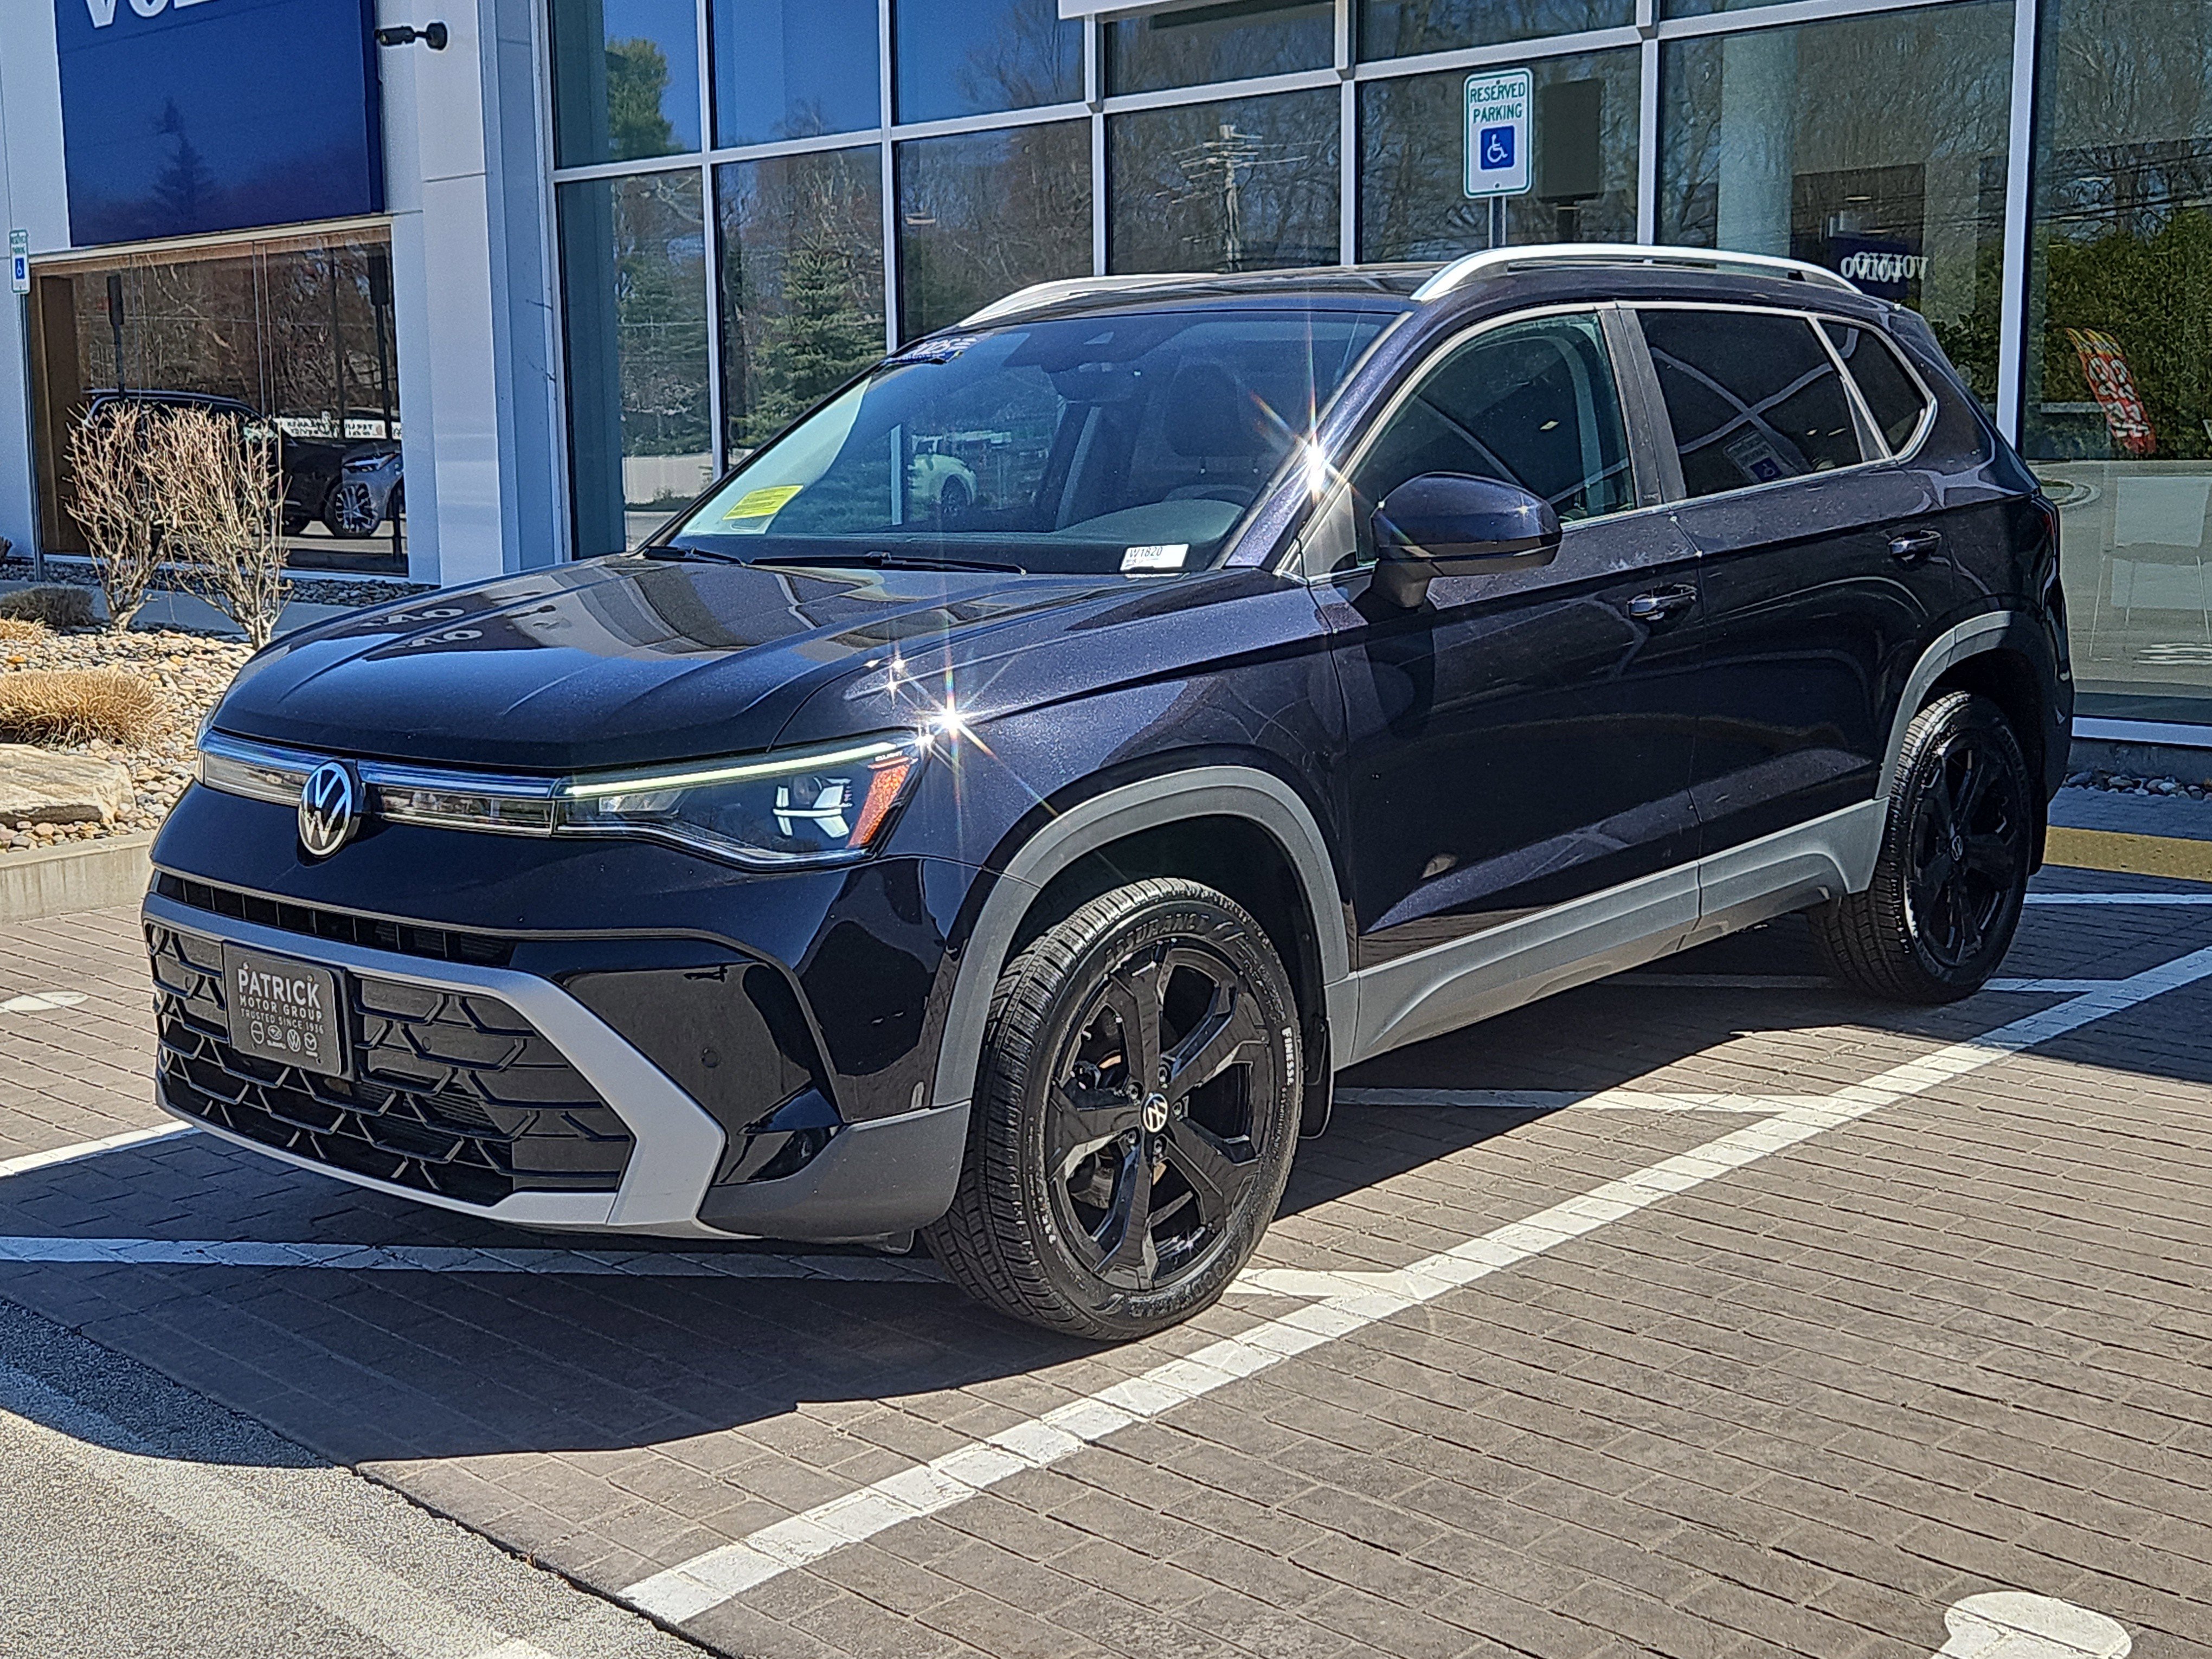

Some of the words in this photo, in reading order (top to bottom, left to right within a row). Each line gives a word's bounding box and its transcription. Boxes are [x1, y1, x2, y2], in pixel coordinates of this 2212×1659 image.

[1470, 82, 1525, 103] RESERVED
[1473, 103, 1522, 124] PARKING
[1130, 546, 1163, 557] W1820
[237, 969, 321, 1009] PATRICK
[239, 994, 278, 1013] MOTOR
[283, 1004, 322, 1022] GROUP
[241, 1008, 275, 1024] TRUSTED
[278, 1016, 303, 1030] SINCE
[1282, 1027, 1295, 1086] FINESSE
